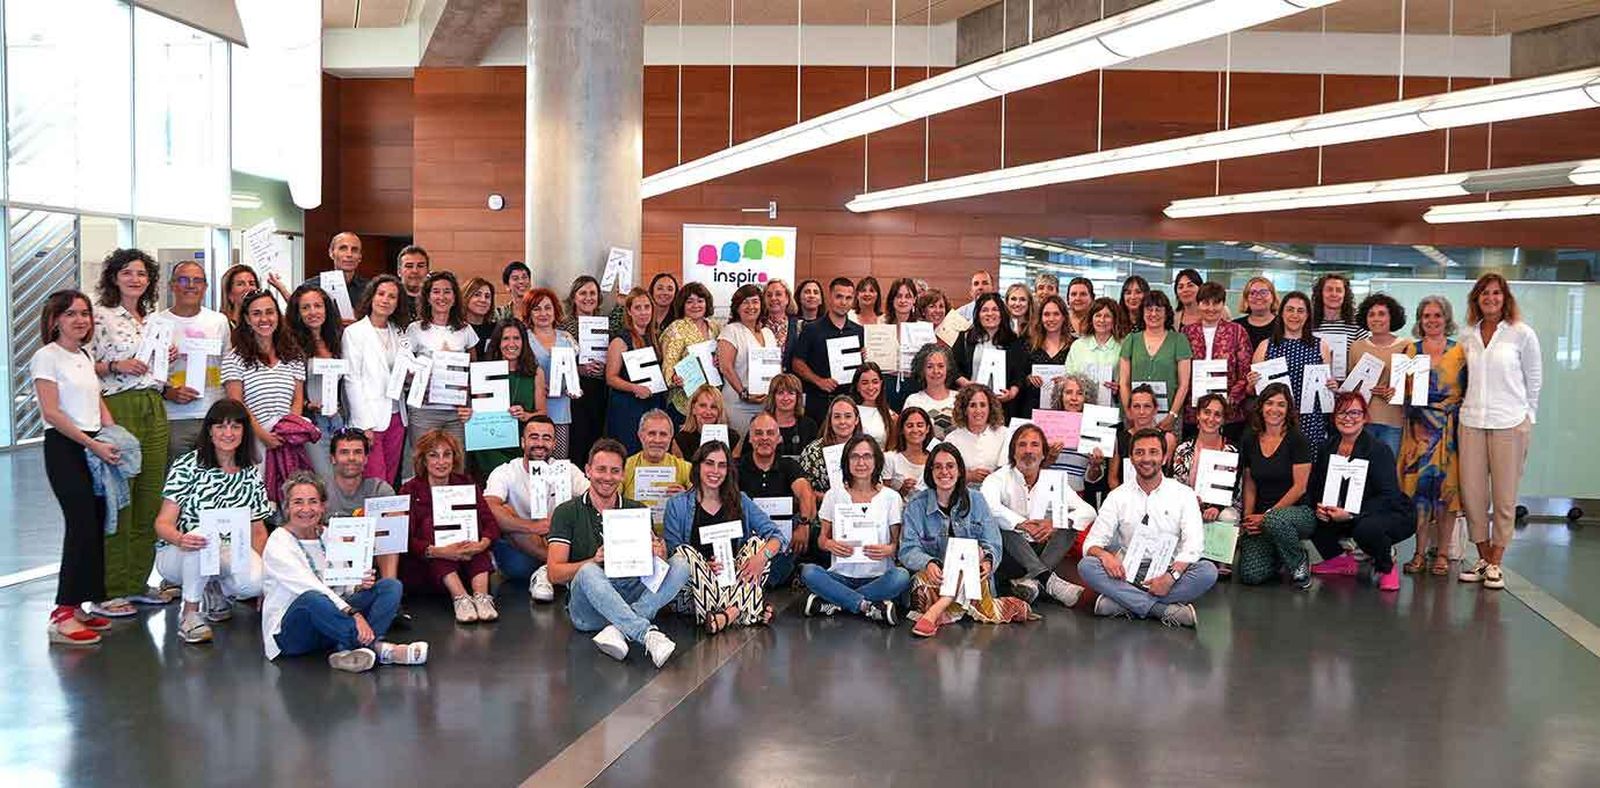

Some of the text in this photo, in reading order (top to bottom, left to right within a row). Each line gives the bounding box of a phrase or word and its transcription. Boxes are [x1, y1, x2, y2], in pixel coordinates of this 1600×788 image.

[578, 315, 609, 364] E
[826, 334, 863, 385] E
[178, 338, 222, 398] T
[312, 357, 350, 416] T
[429, 351, 470, 406] E
[470, 360, 511, 413] S
[549, 346, 582, 397] A
[621, 346, 669, 395] S
[975, 348, 1006, 395] A
[1192, 358, 1228, 408] E
[1300, 364, 1335, 414] A
[1389, 353, 1431, 405] M
[1077, 403, 1121, 458] S
[1194, 448, 1239, 506] E
[1322, 454, 1370, 514] M
[431, 484, 479, 548] S
[699, 520, 743, 587] T
[939, 537, 983, 600] A
